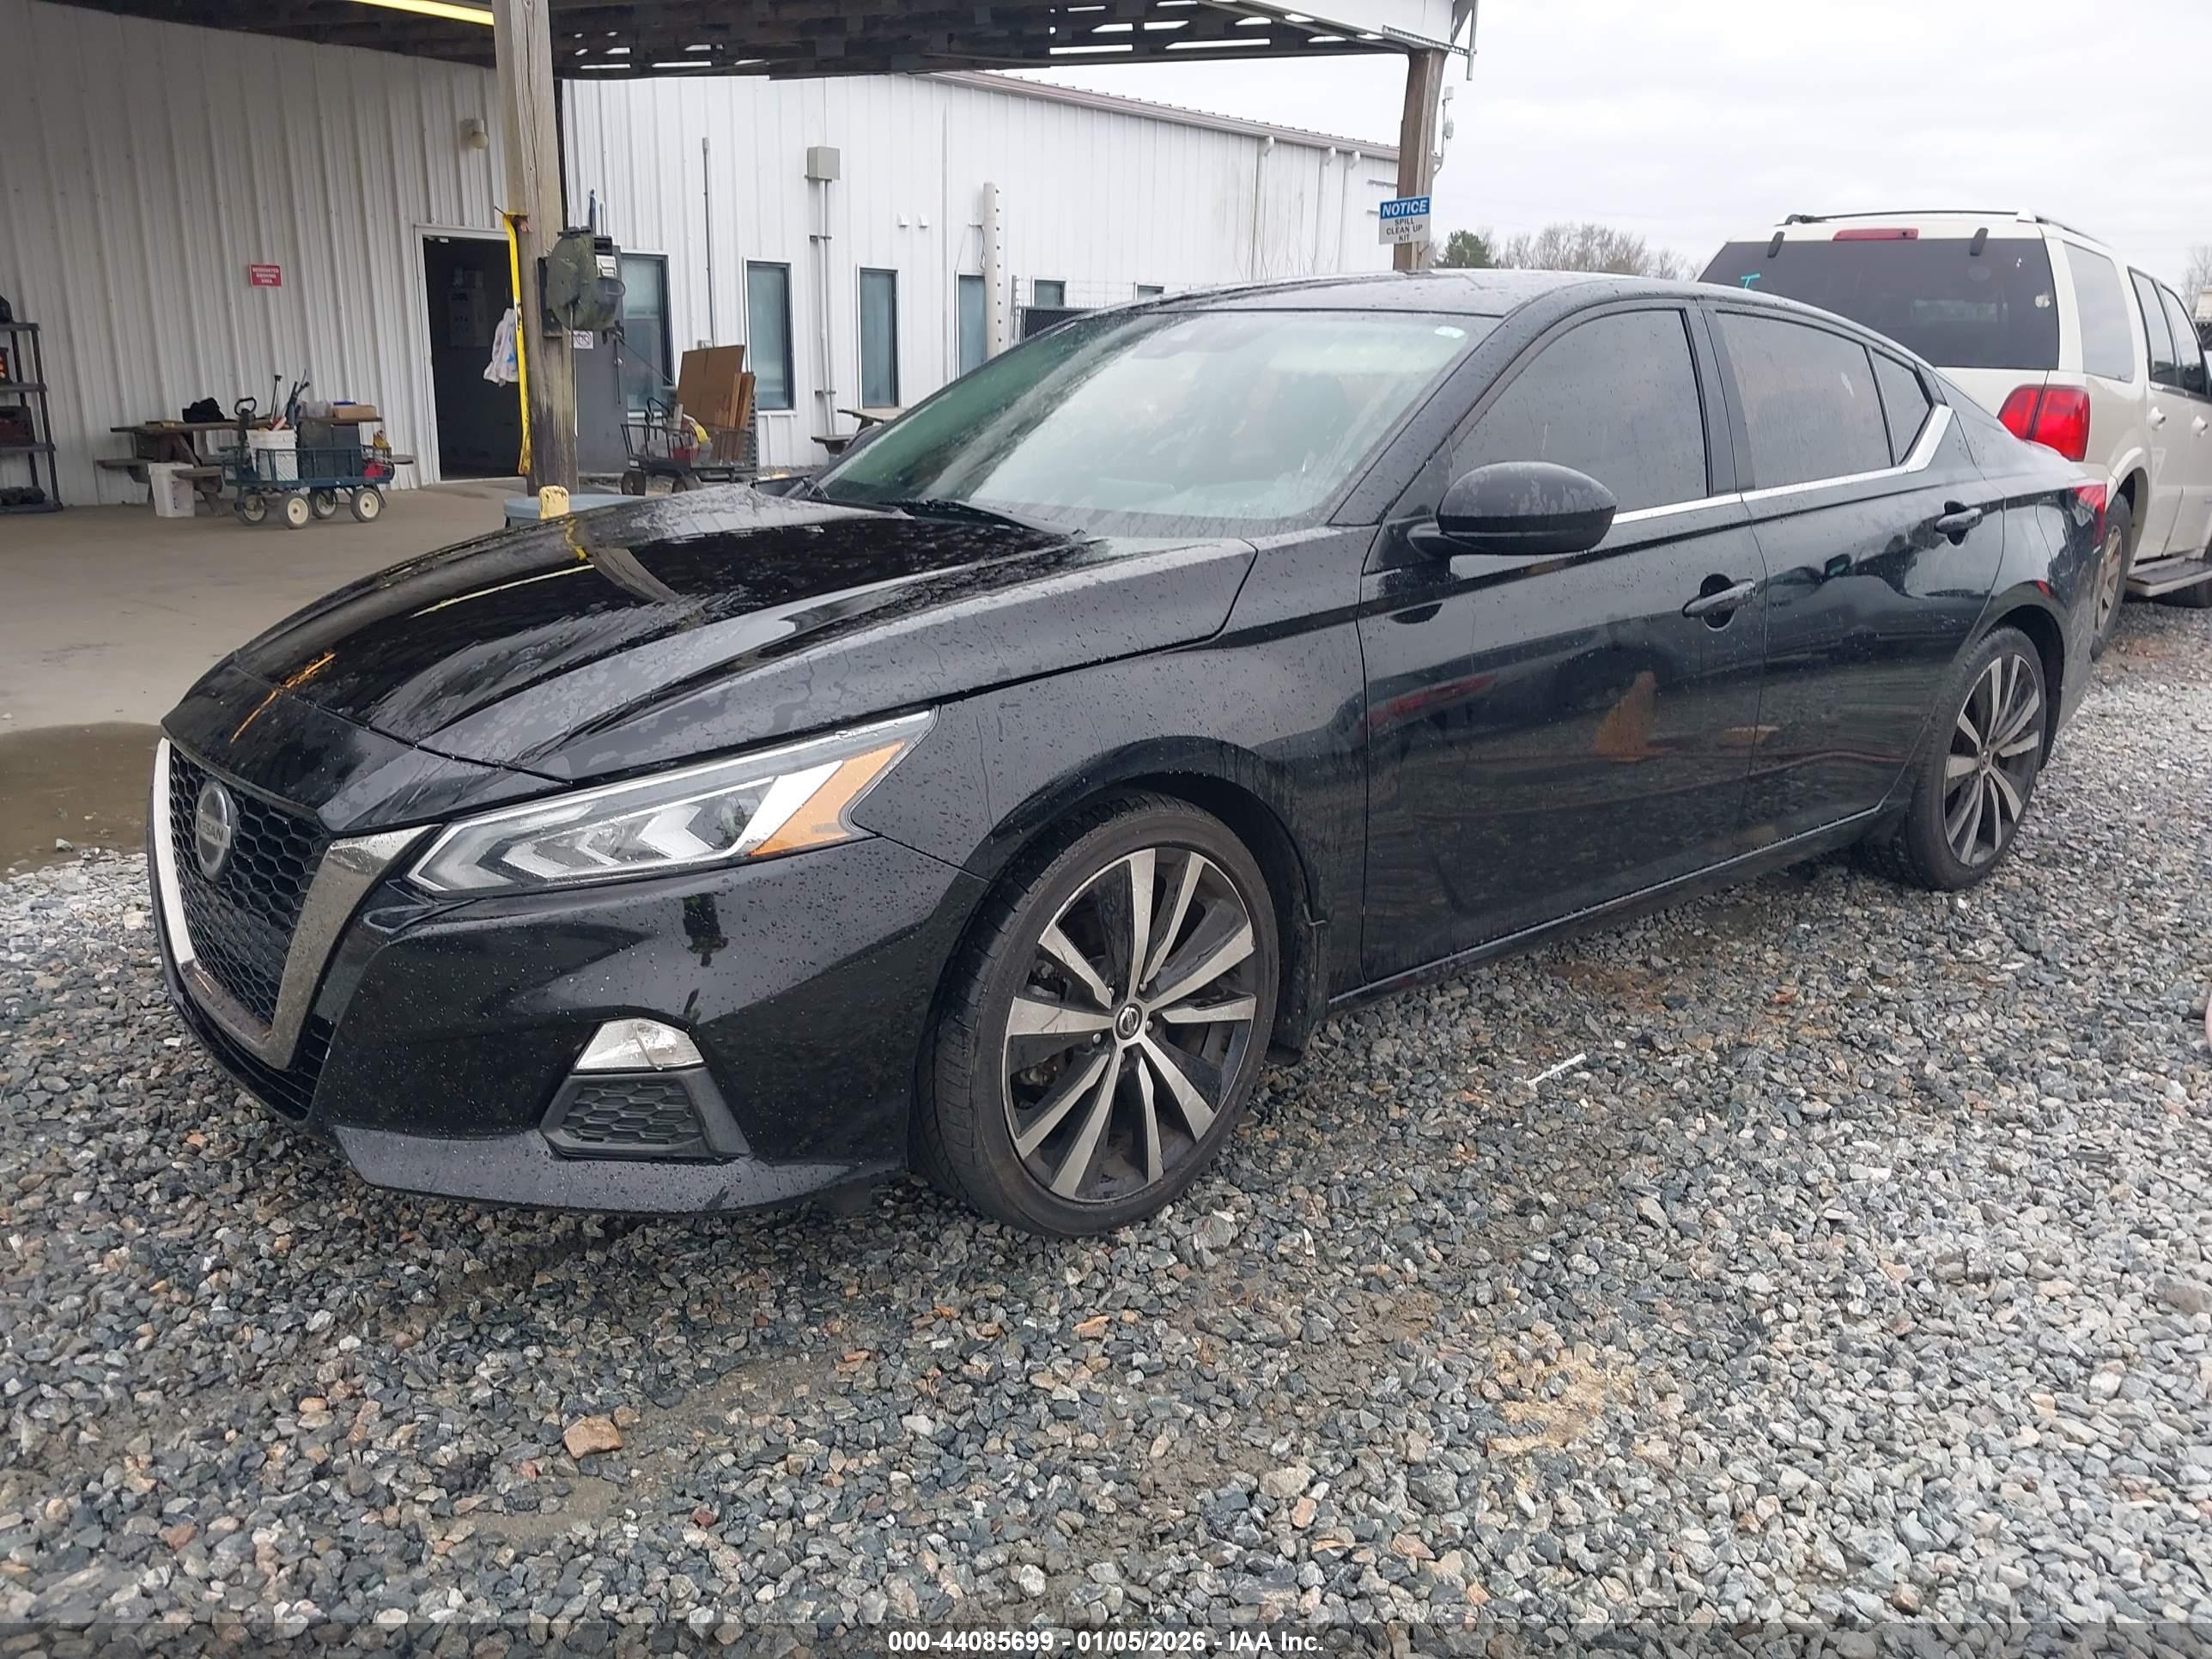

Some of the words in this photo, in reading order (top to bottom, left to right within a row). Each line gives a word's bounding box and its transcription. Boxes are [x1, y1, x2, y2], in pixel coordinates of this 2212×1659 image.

[1382, 200, 1427, 217] NOTICE
[1395, 216, 1414, 226] SPILL
[1386, 227, 1410, 235] CLEAN
[1413, 224, 1423, 233] UP
